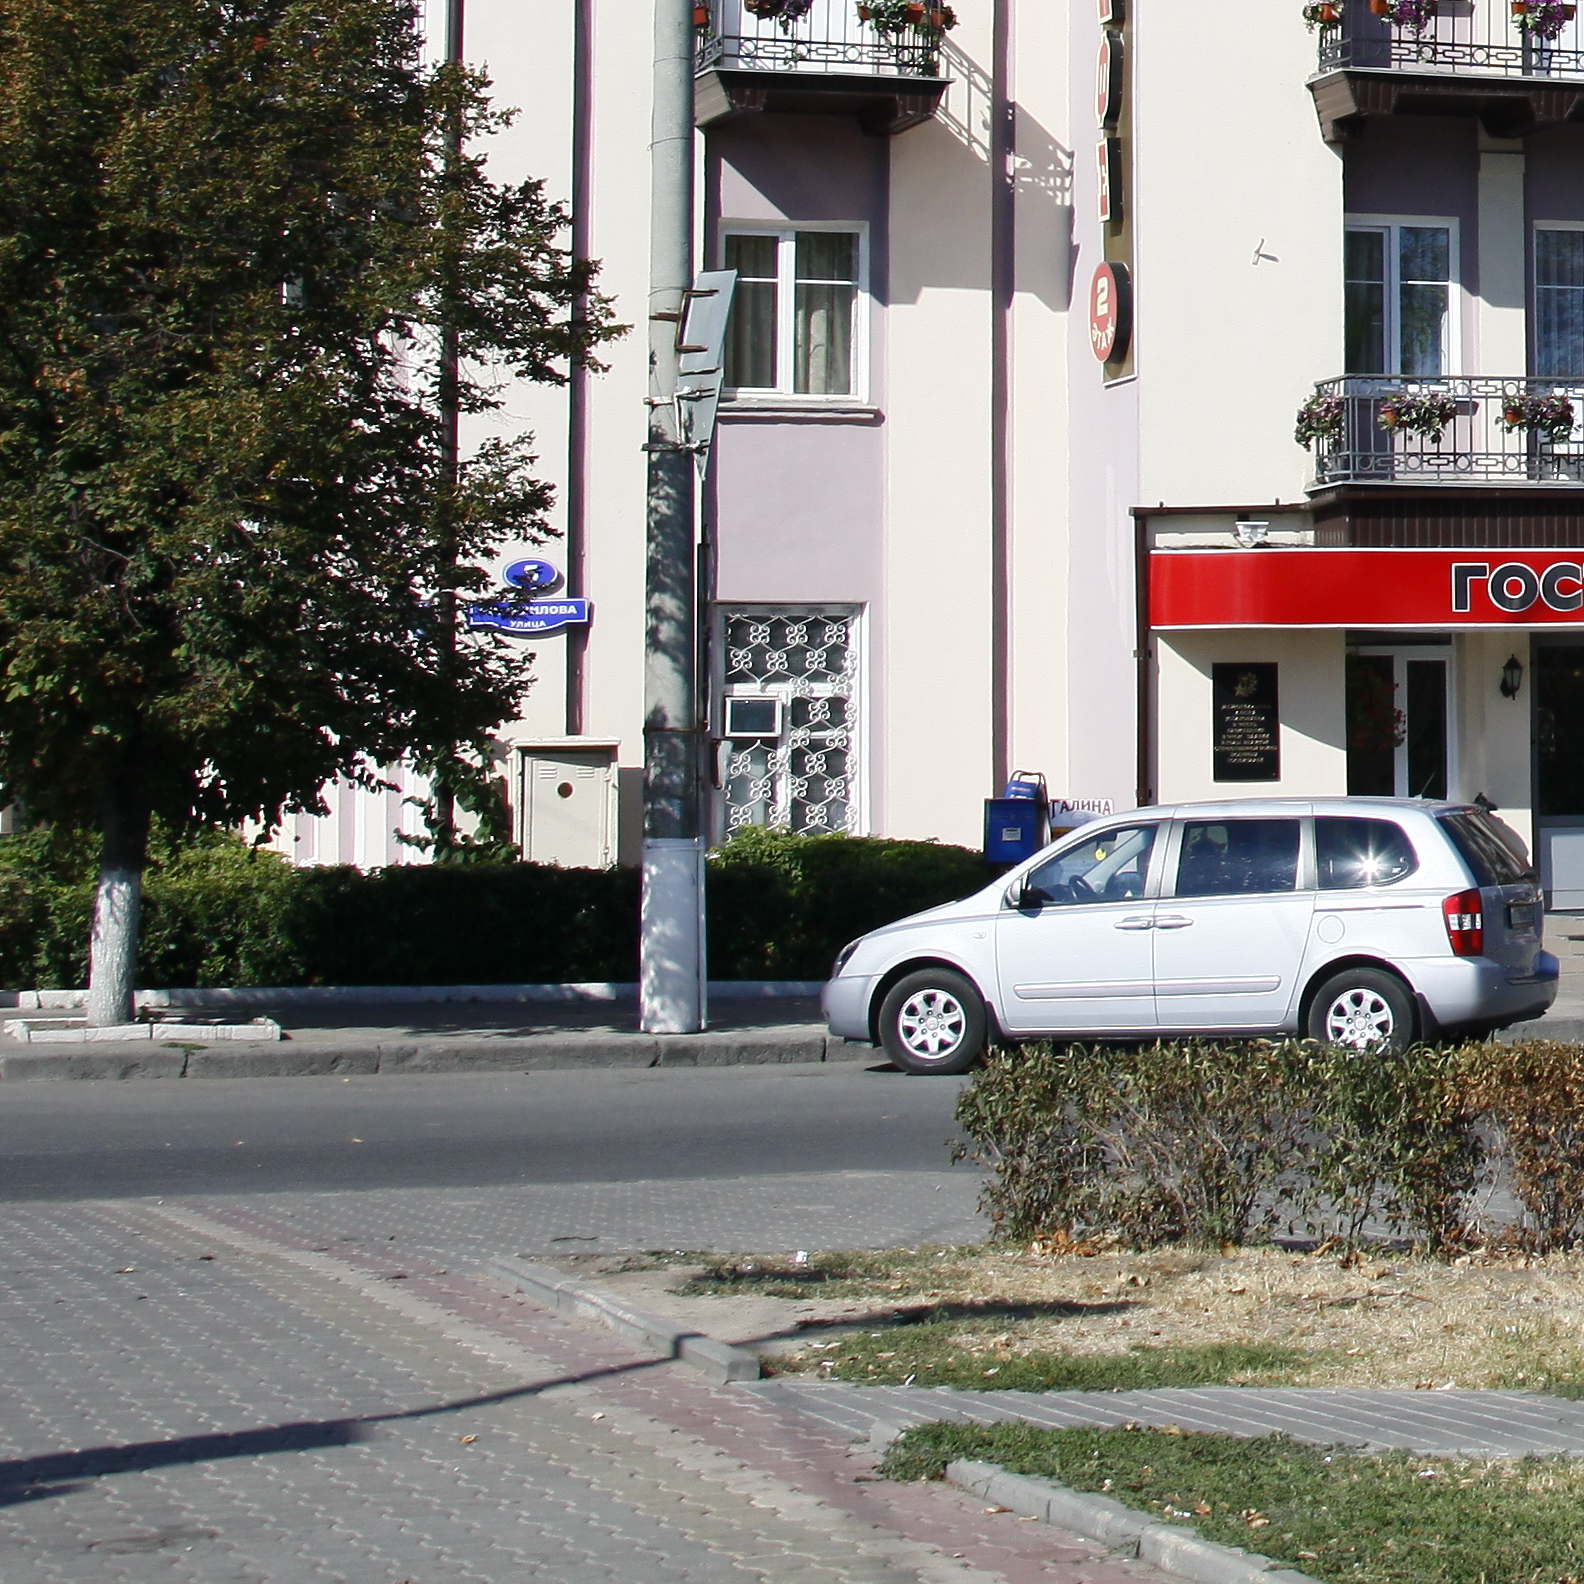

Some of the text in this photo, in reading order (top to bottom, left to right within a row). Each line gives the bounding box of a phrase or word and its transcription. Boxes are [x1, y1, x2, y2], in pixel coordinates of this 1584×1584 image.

[1097, 276, 1109, 317] 2
[509, 620, 547, 629] УЛИЦА
[1050, 799, 1111, 819] ГАЛИНА
